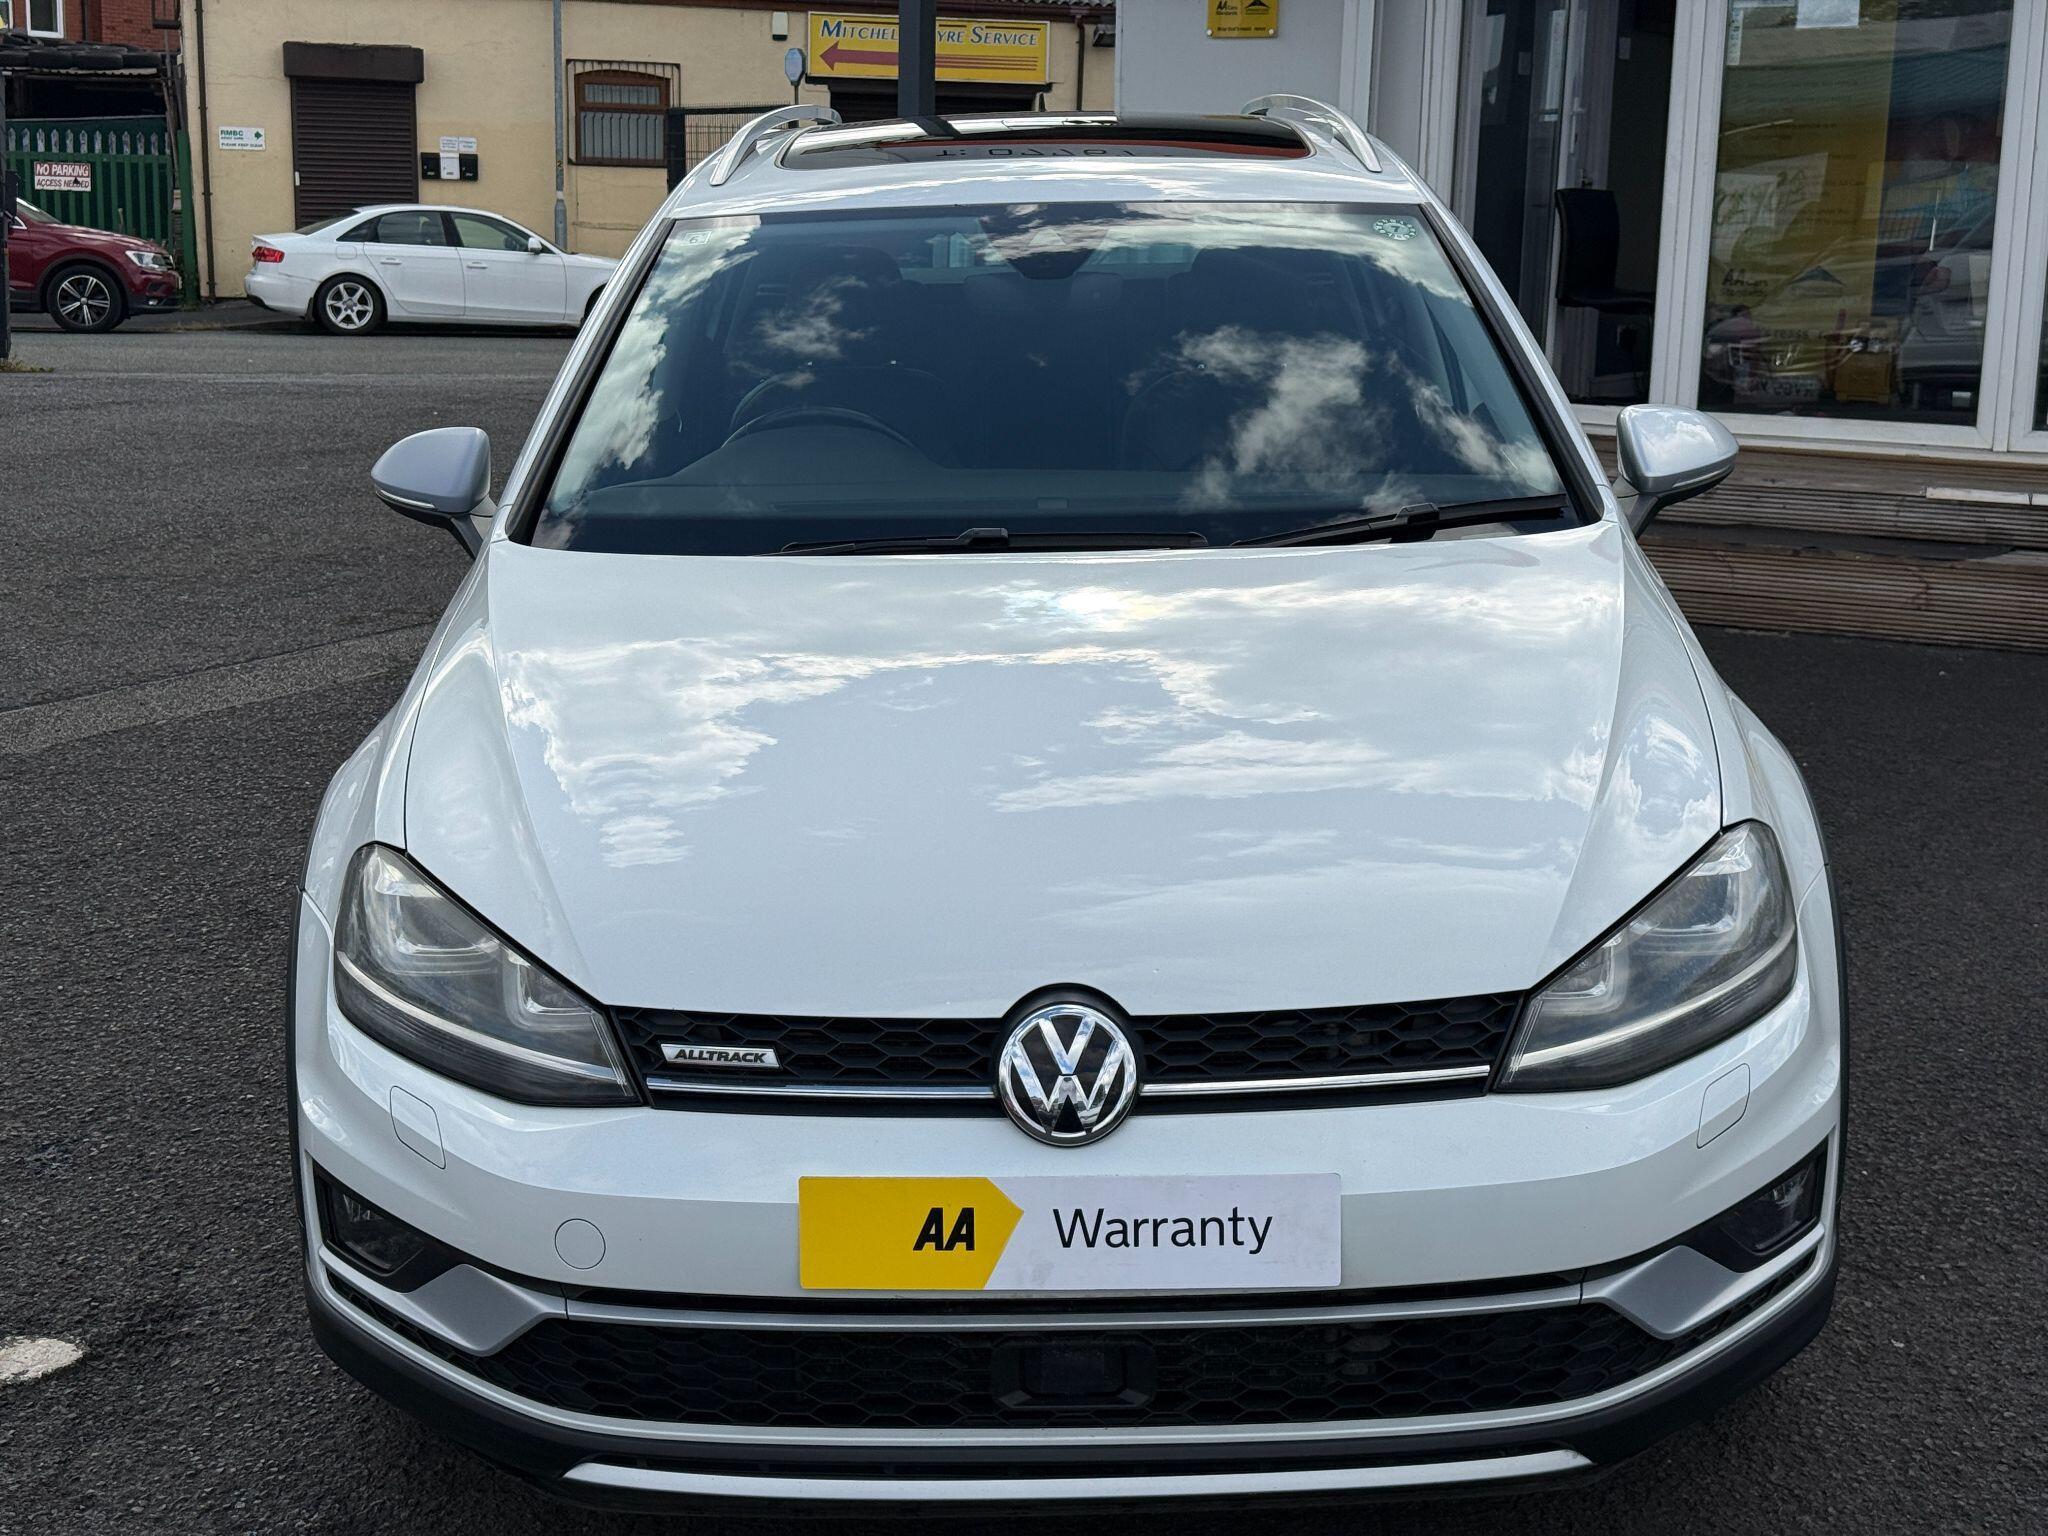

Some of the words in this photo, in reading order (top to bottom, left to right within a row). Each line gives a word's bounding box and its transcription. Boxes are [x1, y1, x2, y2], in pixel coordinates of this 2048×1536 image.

[821, 19, 898, 40] MITCHEL
[937, 30, 965, 43] YRE
[970, 26, 1037, 45] SERVICE
[36, 163, 50, 176] NO
[52, 164, 89, 177] PARKING
[36, 178, 62, 187] ACCESS
[673, 1048, 768, 1064] ALLTRACK
[912, 1206, 976, 1252] AA
[1052, 1205, 1274, 1256] Warranty
